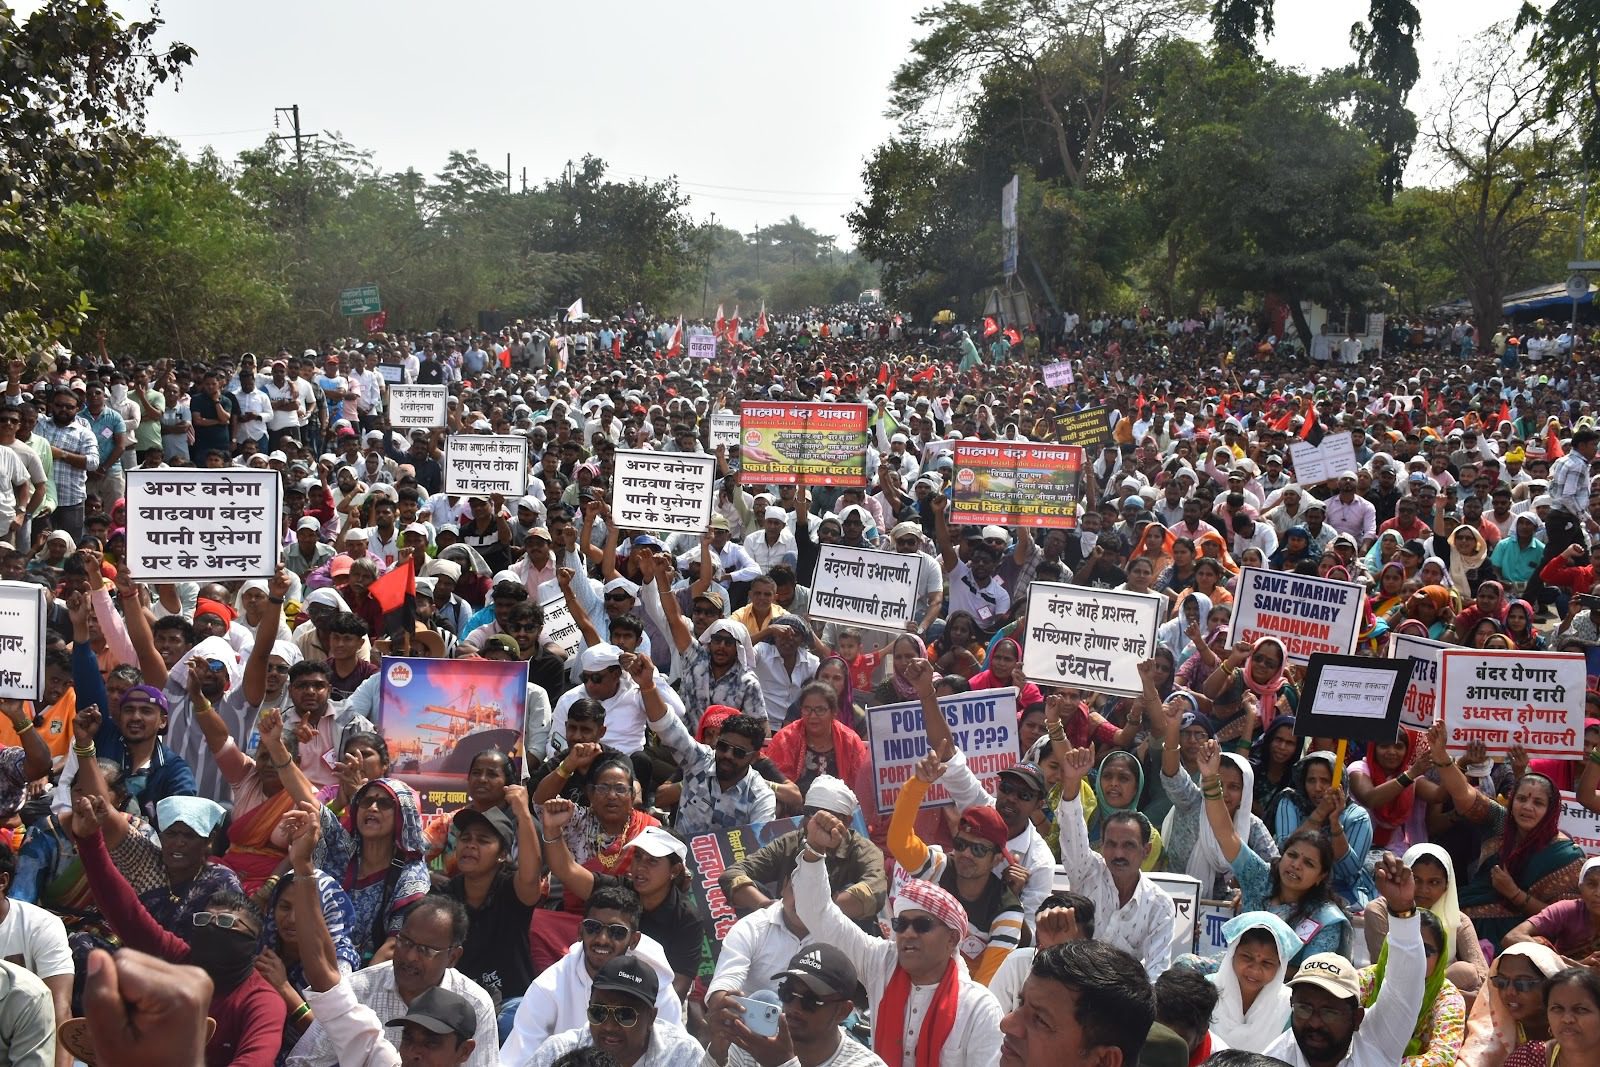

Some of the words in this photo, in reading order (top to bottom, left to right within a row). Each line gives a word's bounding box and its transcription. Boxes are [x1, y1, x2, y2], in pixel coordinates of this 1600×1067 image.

[393, 390, 404, 398] एक
[405, 388, 417, 399] दोन
[419, 388, 431, 398] तीन
[743, 408, 785, 418] वाढवण
[789, 405, 813, 419] बंदर
[817, 406, 856, 419] थांबवा
[450, 439, 467, 452] धोका
[470, 441, 497, 456] अणुशक्ती
[957, 447, 1000, 457] वाढवण
[1003, 445, 1028, 459] बंदर
[1032, 448, 1070, 460] थांबवा
[453, 459, 491, 475] म्हणूनच
[493, 457, 518, 471] ठोका
[625, 460, 661, 472] अगर
[664, 461, 704, 474] बनेगा
[743, 463, 767, 472] एकच
[792, 465, 827, 474] वाढवण
[144, 482, 197, 496] अगर
[201, 477, 261, 496] बनेगा
[456, 479, 468, 489] या
[622, 477, 671, 489] वाढवण
[675, 477, 704, 494] बंदर
[626, 492, 657, 505] पानी
[660, 494, 702, 511] घुसेगा
[955, 502, 980, 511] एकच
[1005, 504, 1039, 513] वाढवण
[139, 507, 215, 521] वाढवण
[220, 502, 264, 524] बंदर
[622, 511, 642, 521] घर
[645, 508, 659, 522] के
[663, 514, 700, 527] अन्दर
[146, 526, 194, 545] पानी
[199, 525, 262, 551] घुसेगा
[142, 556, 173, 570] घर
[178, 550, 199, 569] के
[204, 555, 261, 572] अन्दर
[824, 552, 865, 578] बंदराची
[1253, 575, 1288, 594] SAVE
[1290, 582, 1348, 605] MARINE
[816, 587, 880, 615] पर्यावरणाची
[1048, 594, 1073, 618] बंदर
[1075, 598, 1100, 622] आहे
[1254, 594, 1341, 622] SANCTUARY
[1256, 612, 1330, 640] WADHVAN
[1033, 622, 1082, 648] मच्छिमार
[1084, 628, 1119, 652] होणार
[1122, 634, 1146, 658] आहे
[1476, 661, 1507, 681] बंदर
[1512, 663, 1557, 683] येणार
[1323, 679, 1338, 688] समुद्र
[1466, 686, 1529, 701] आपल्या
[1533, 685, 1566, 703] दारी
[891, 710, 926, 734] POR
[962, 701, 996, 725] NOT
[1463, 706, 1513, 721] उध्वस्त
[1517, 704, 1568, 724] होणार
[974, 726, 1009, 750] ???
[1453, 728, 1509, 743] आपला
[1513, 726, 1576, 746] शेतकरी
[880, 765, 912, 784] PORT
[429, 791, 447, 806] समुद्र
[449, 792, 467, 803] वाचवा
[800, 959, 821, 970] adidas
[1304, 961, 1341, 975] GUCCI
